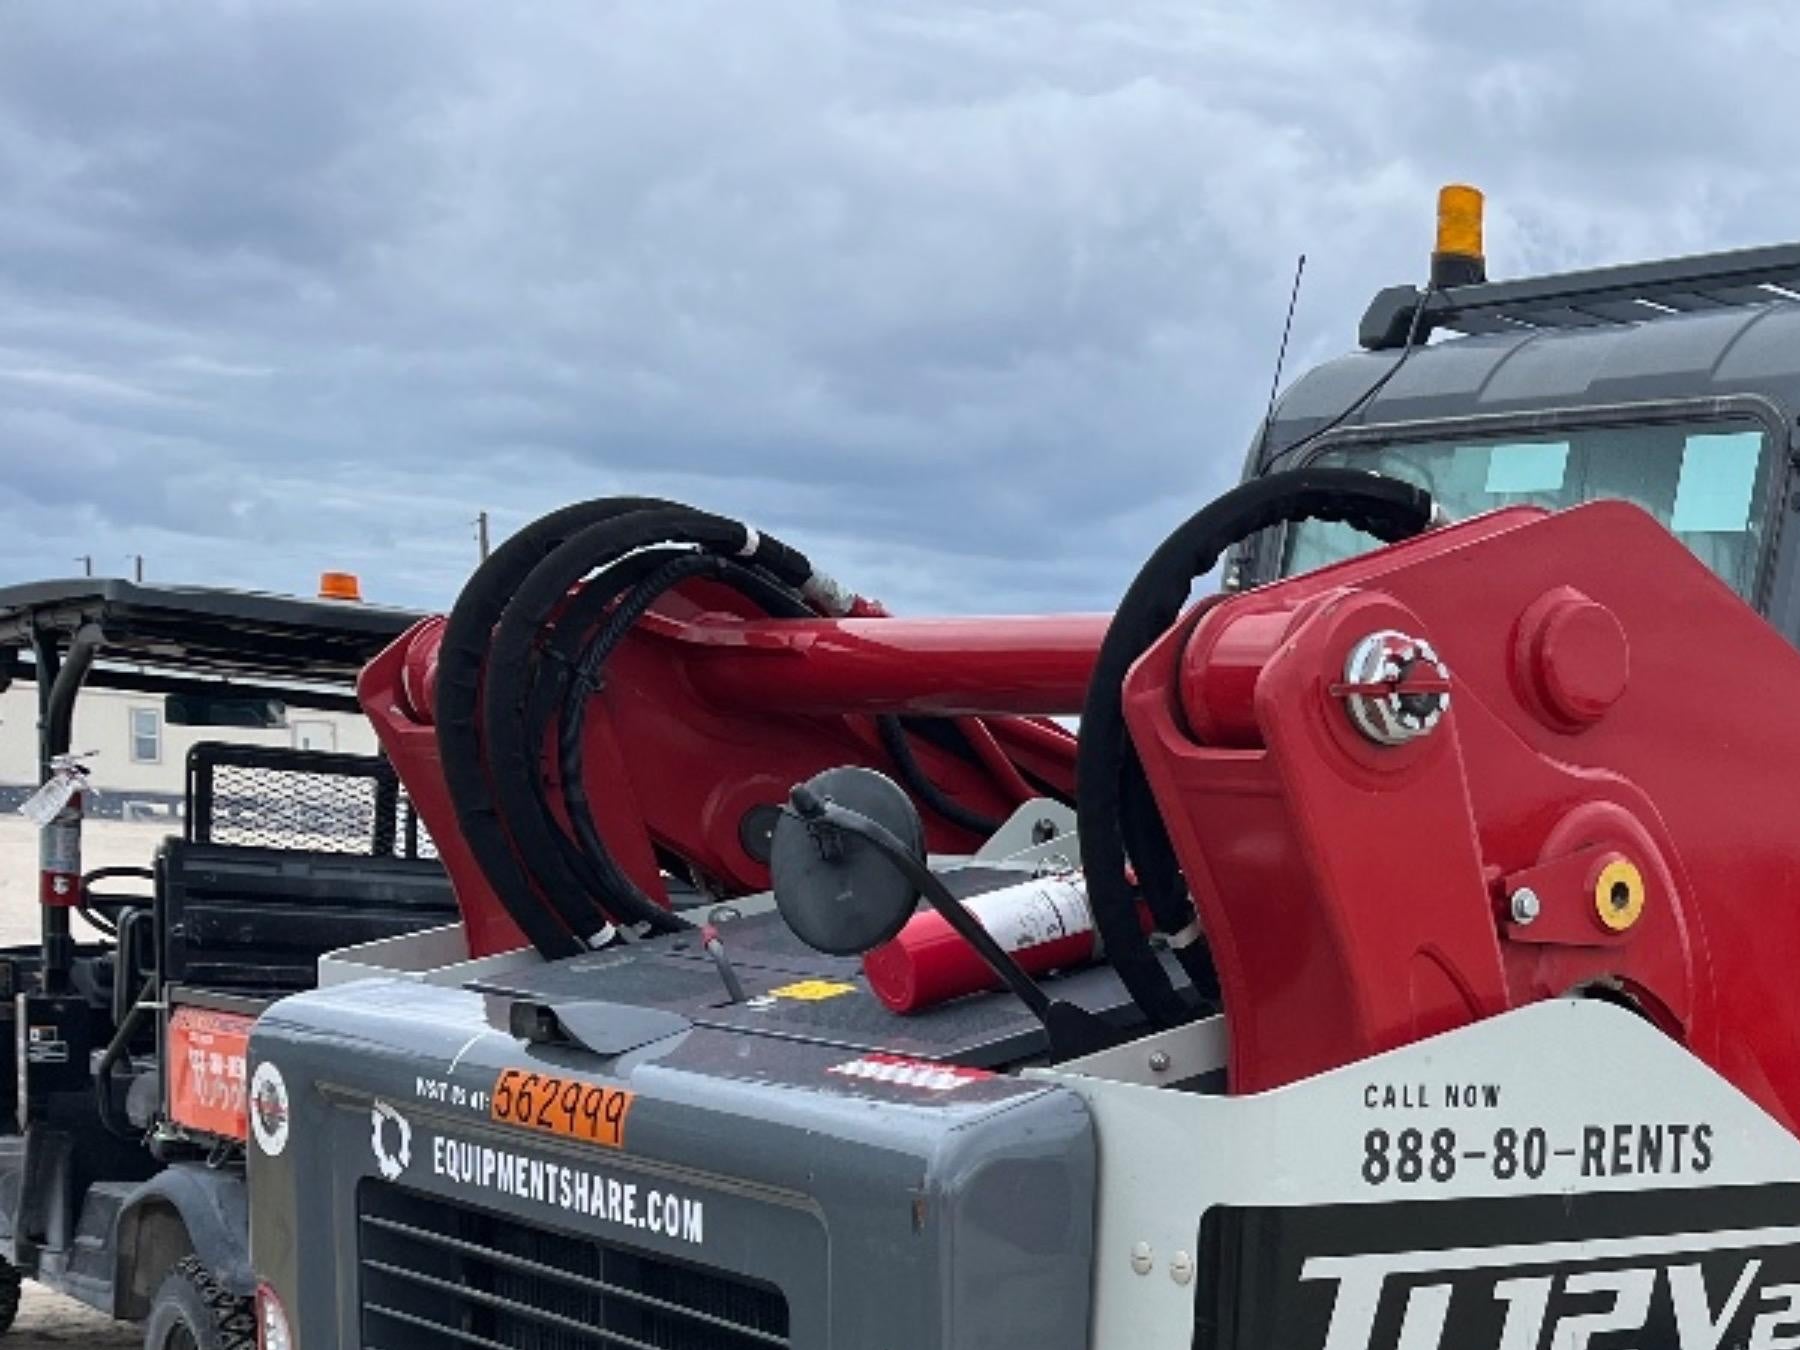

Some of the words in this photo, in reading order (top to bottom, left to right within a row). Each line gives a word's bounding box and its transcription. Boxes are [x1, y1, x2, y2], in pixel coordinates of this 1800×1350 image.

[495, 1070, 626, 1143] 562999
[1364, 1084, 1430, 1108] CALL
[1445, 1084, 1501, 1108] NOW
[1361, 1122, 1714, 1186] 888-80-RENTS
[433, 1135, 704, 1244] EQUIPMENTSHARE.COM
